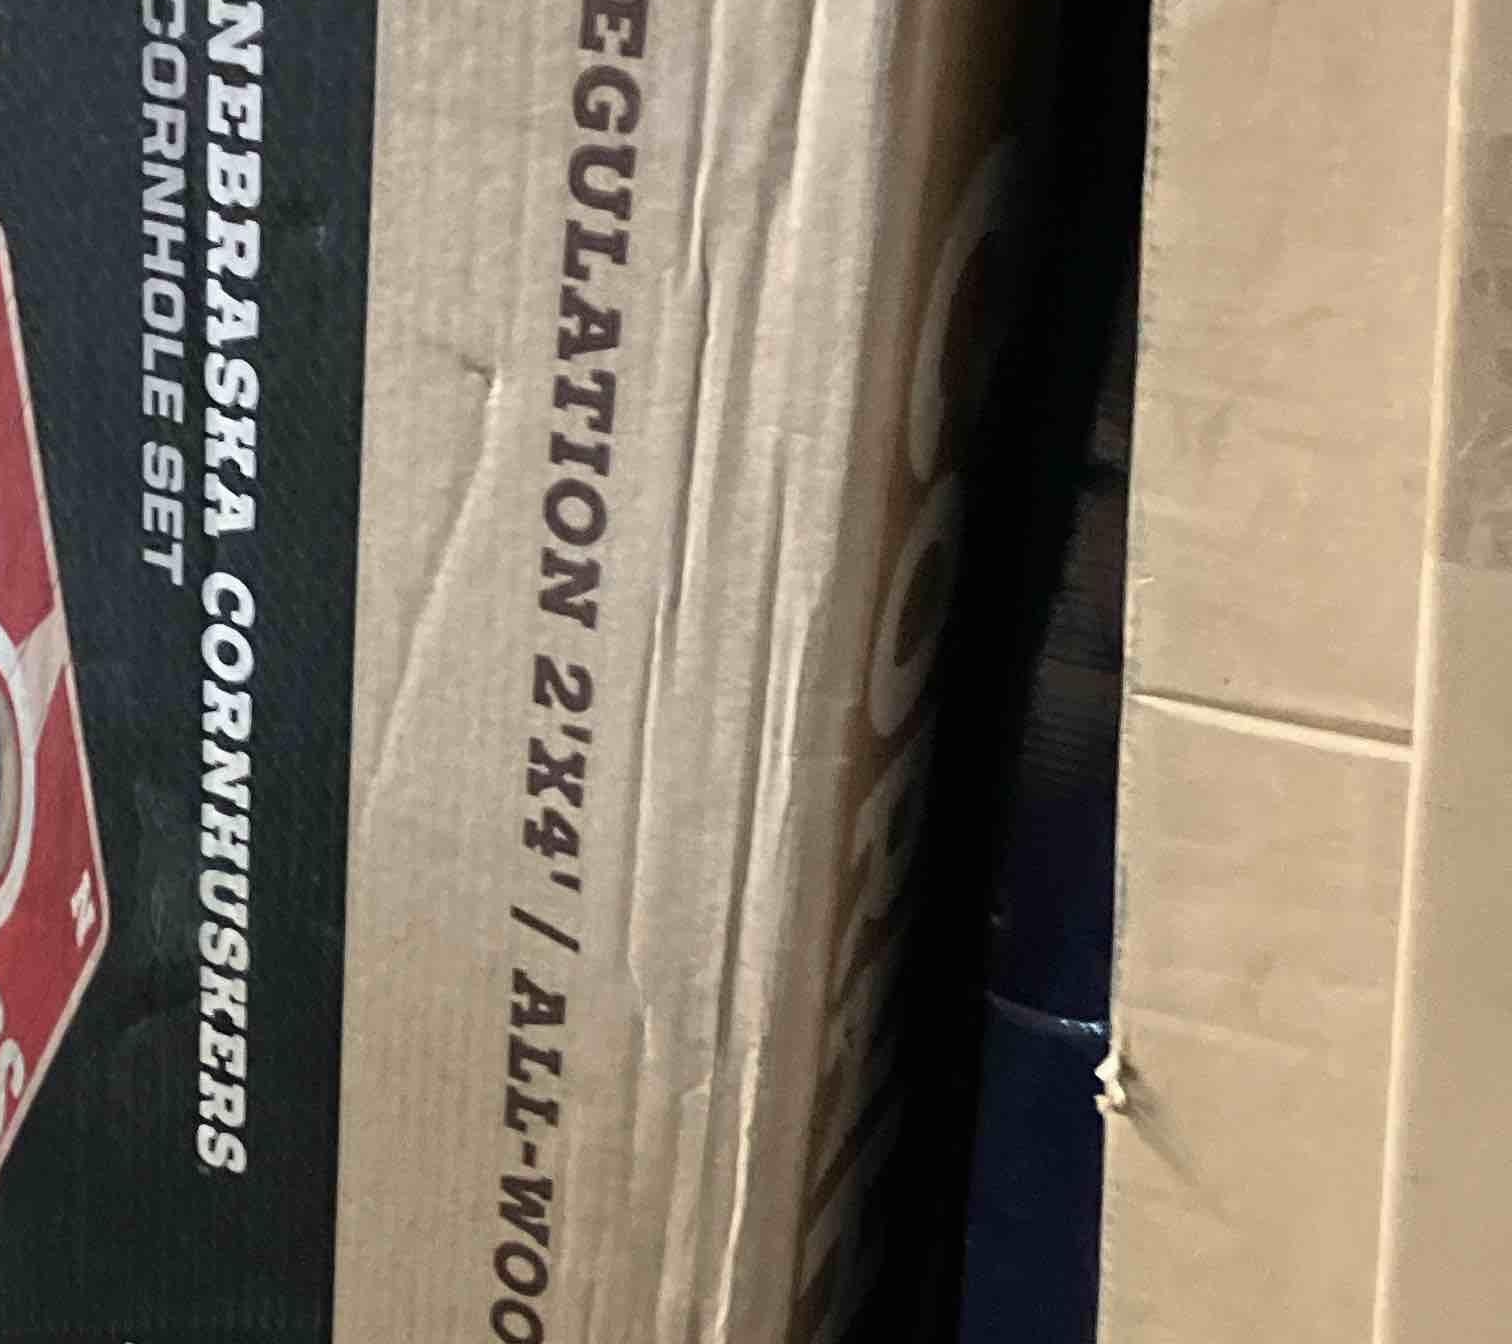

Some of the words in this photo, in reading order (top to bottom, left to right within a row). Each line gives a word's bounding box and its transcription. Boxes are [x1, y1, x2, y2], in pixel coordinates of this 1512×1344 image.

[141, 439, 185, 587] SET
[196, 570, 257, 1175] CORNHUSKERS
[522, 653, 595, 893] 2'X4'
